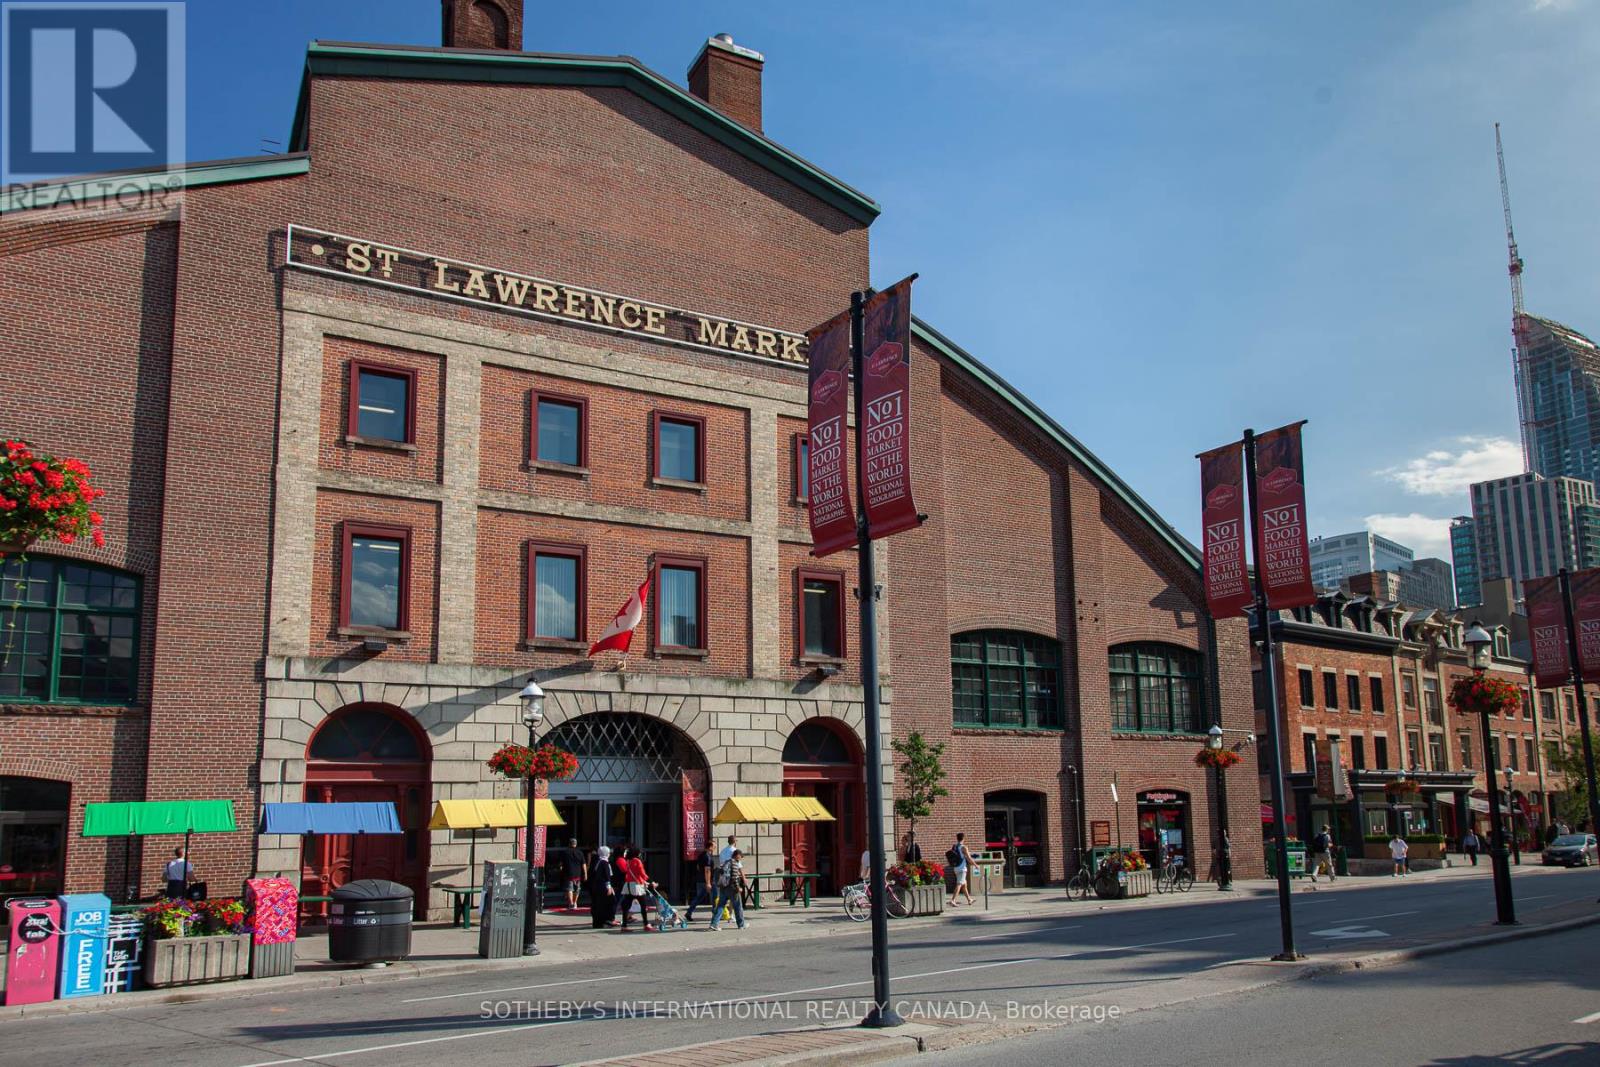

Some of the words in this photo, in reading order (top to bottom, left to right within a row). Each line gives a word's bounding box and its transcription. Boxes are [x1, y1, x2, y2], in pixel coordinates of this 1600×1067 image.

[434, 258, 667, 335] LAWRENCE
[697, 318, 810, 363] MARK
[867, 422, 903, 447] FOOD
[867, 436, 902, 457] MARKET
[812, 446, 841, 470] FOOD
[867, 460, 878, 473] IN
[879, 451, 903, 468] THE
[812, 460, 840, 479] MARKET
[867, 463, 903, 484] WORLD
[812, 482, 821, 495] IN
[822, 473, 841, 490] THE
[868, 479, 904, 497] NATIONAL
[812, 486, 843, 505] WORLD
[813, 500, 845, 517] NATIONAL
[1264, 526, 1301, 544] FOOD
[1265, 537, 1301, 551] MARKET
[1208, 540, 1240, 557] FOOD
[1265, 552, 1278, 562] IN
[1279, 548, 1303, 560] THE
[1209, 551, 1240, 565] MARKET
[1266, 557, 1304, 570] WORLD
[1209, 566, 1219, 576] IN
[1222, 560, 1241, 572] THE
[1209, 570, 1242, 583] WORLD
[1267, 567, 1304, 580] NATIONAL
[75, 911, 102, 922] JOB
[76, 938, 94, 989] FREE
